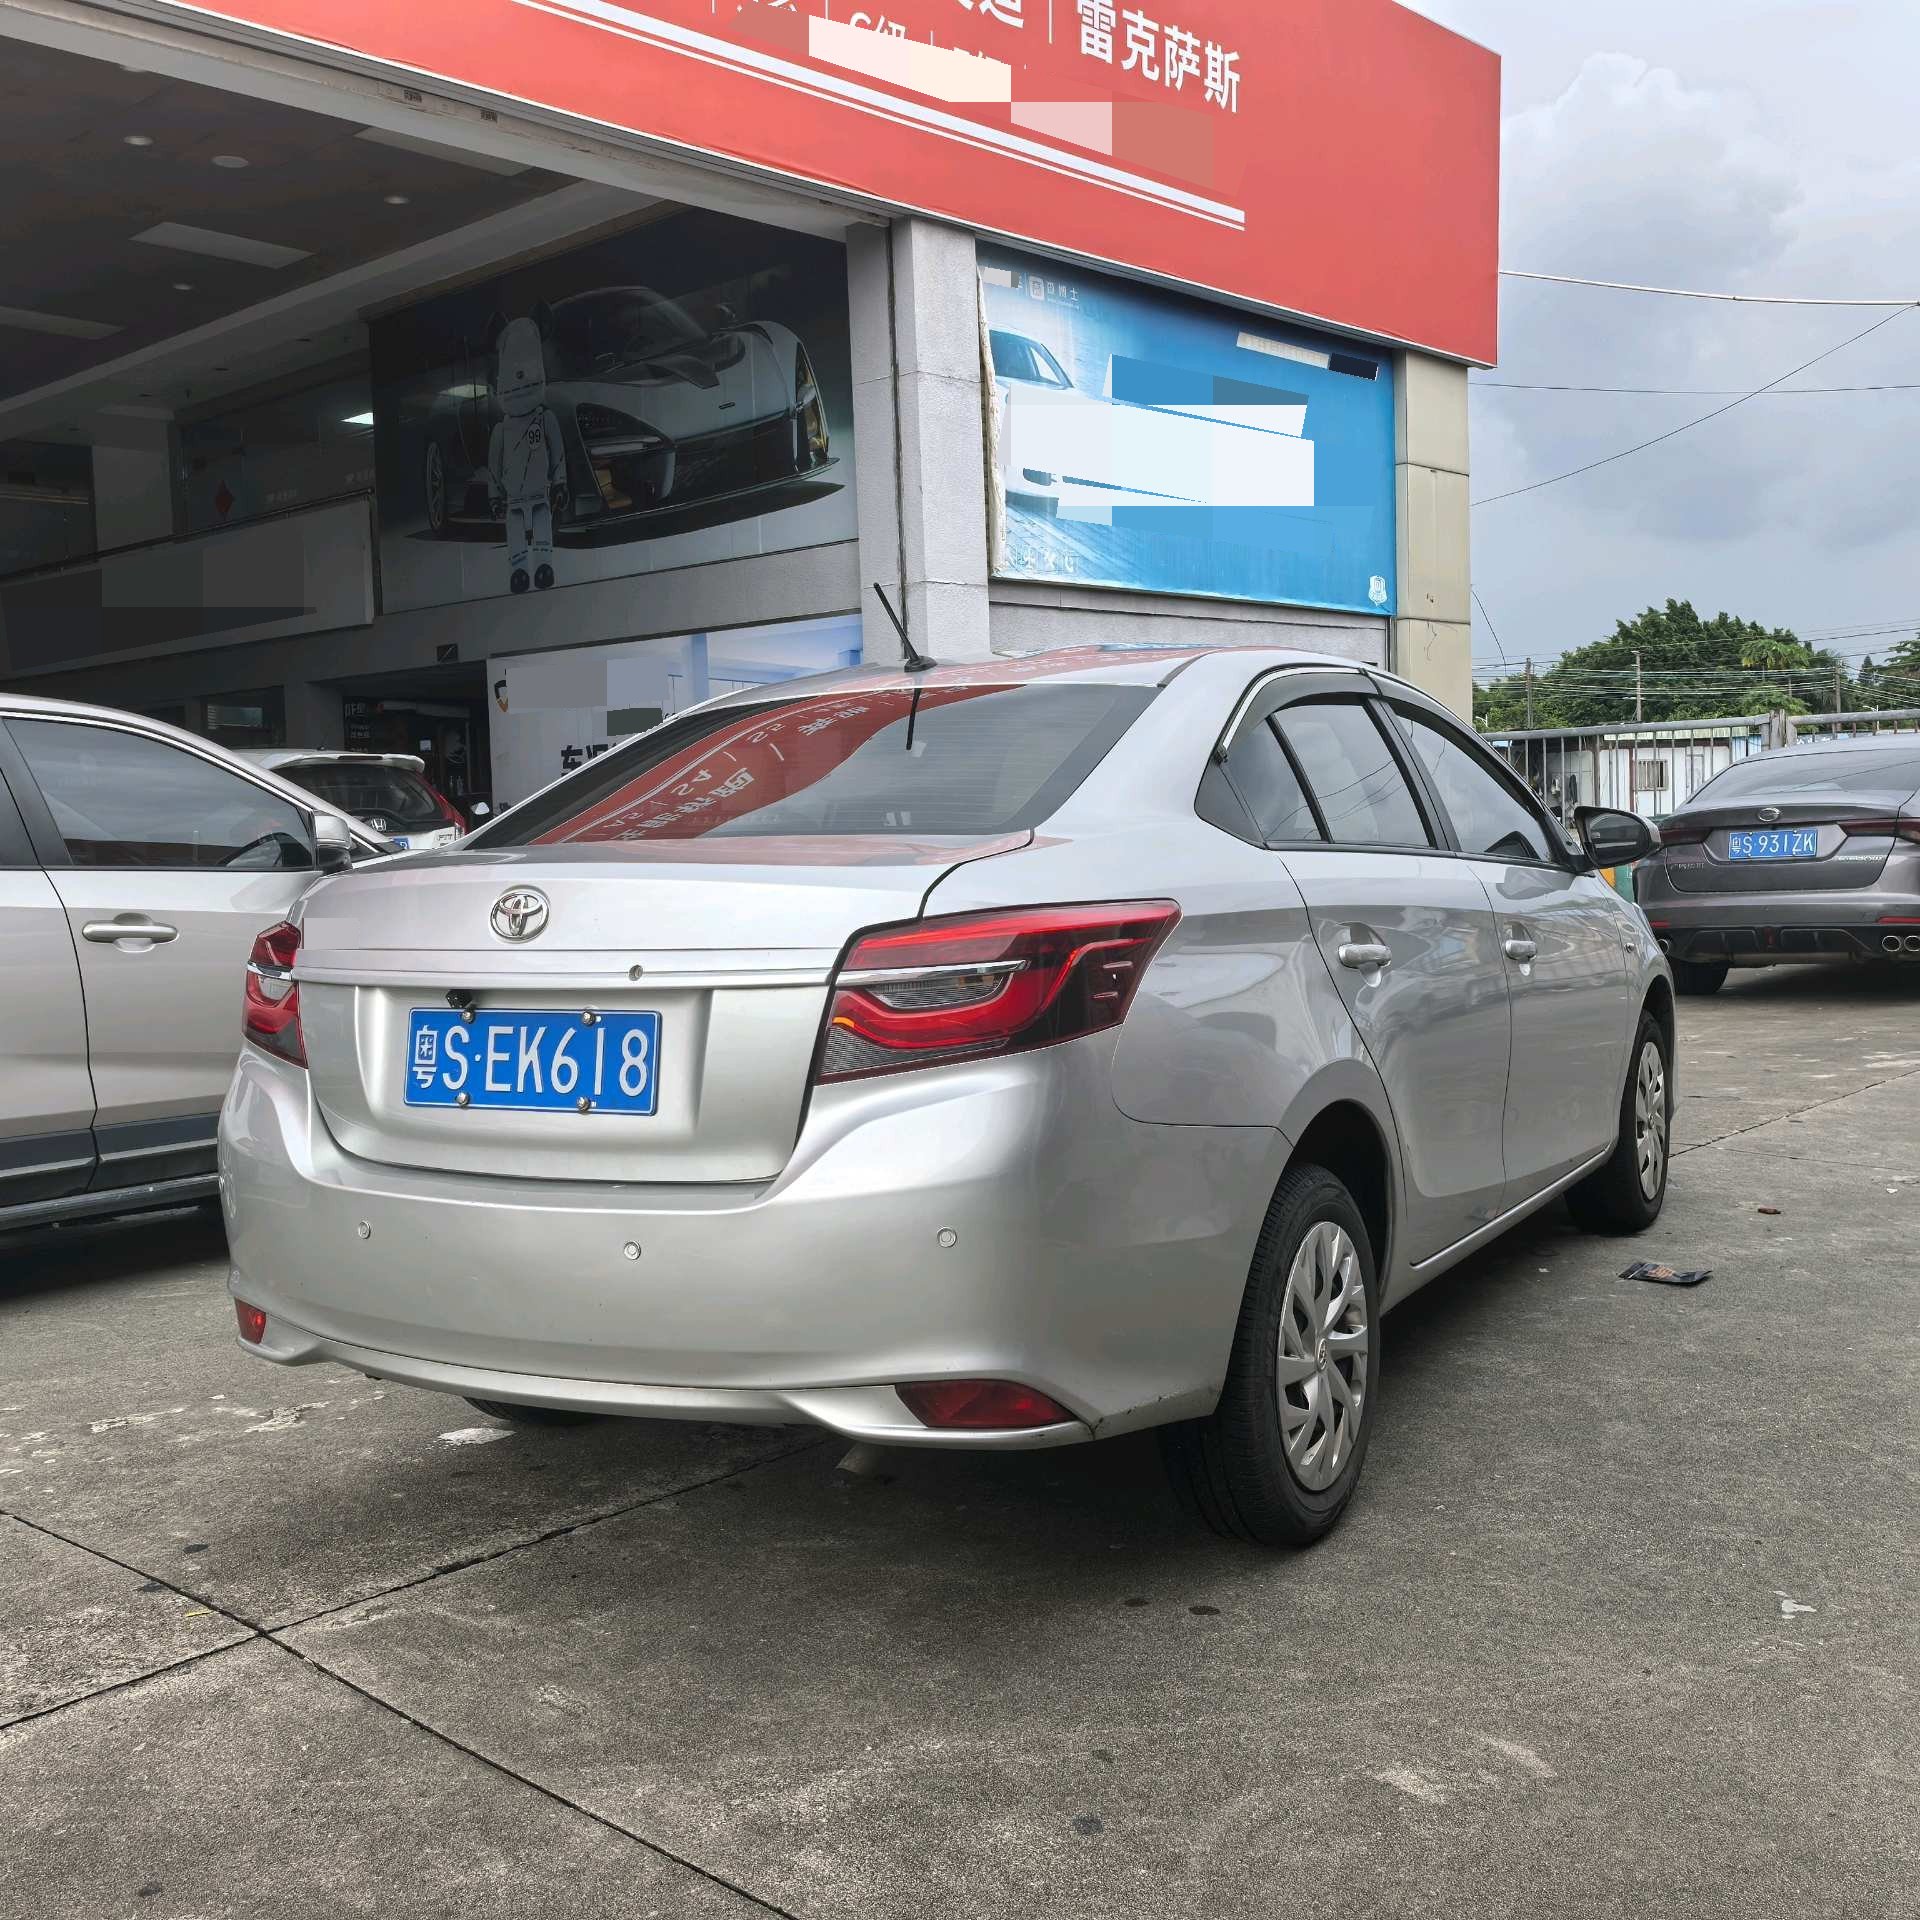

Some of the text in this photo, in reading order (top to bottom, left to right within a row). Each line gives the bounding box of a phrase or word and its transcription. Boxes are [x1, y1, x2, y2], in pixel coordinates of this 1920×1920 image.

[1077, 0, 1240, 112] 雷克萨斯
[412, 1024, 649, 1097] 粤S·EK618
